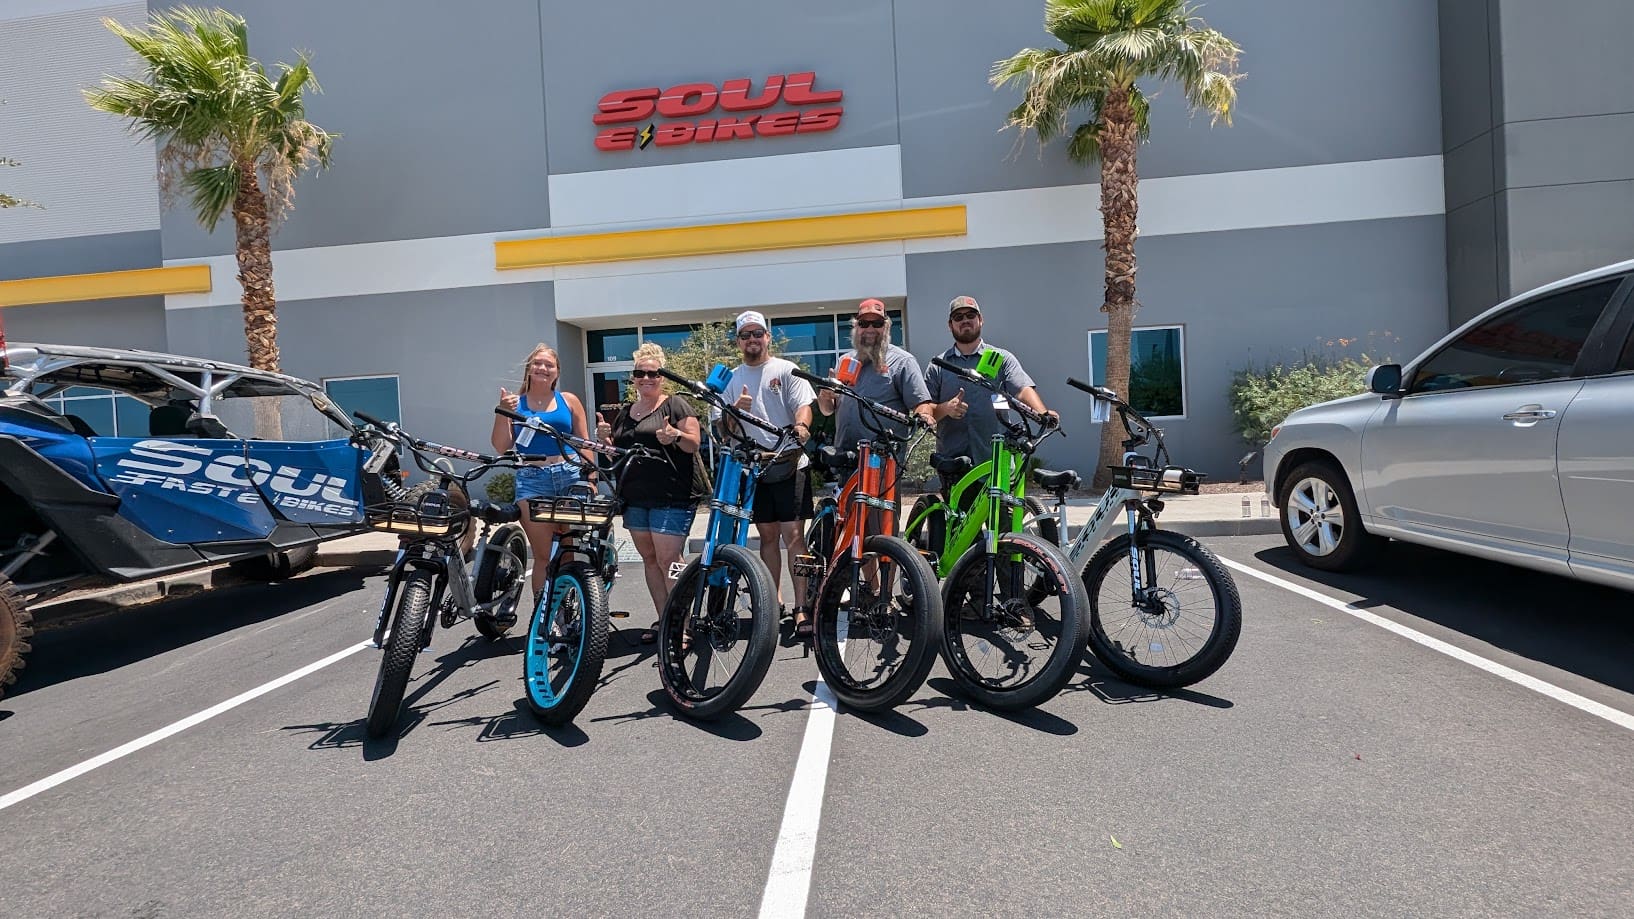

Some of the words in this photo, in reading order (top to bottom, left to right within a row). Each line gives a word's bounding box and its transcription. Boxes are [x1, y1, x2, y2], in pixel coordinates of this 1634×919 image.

[593, 71, 843, 125] SOUL
[594, 126, 638, 150] E
[654, 107, 843, 147] BIKES
[109, 470, 238, 498] FAST
[280, 496, 356, 516] BIKES
[116, 440, 359, 506] SOUL
[1130, 545, 1141, 594] SOUL
